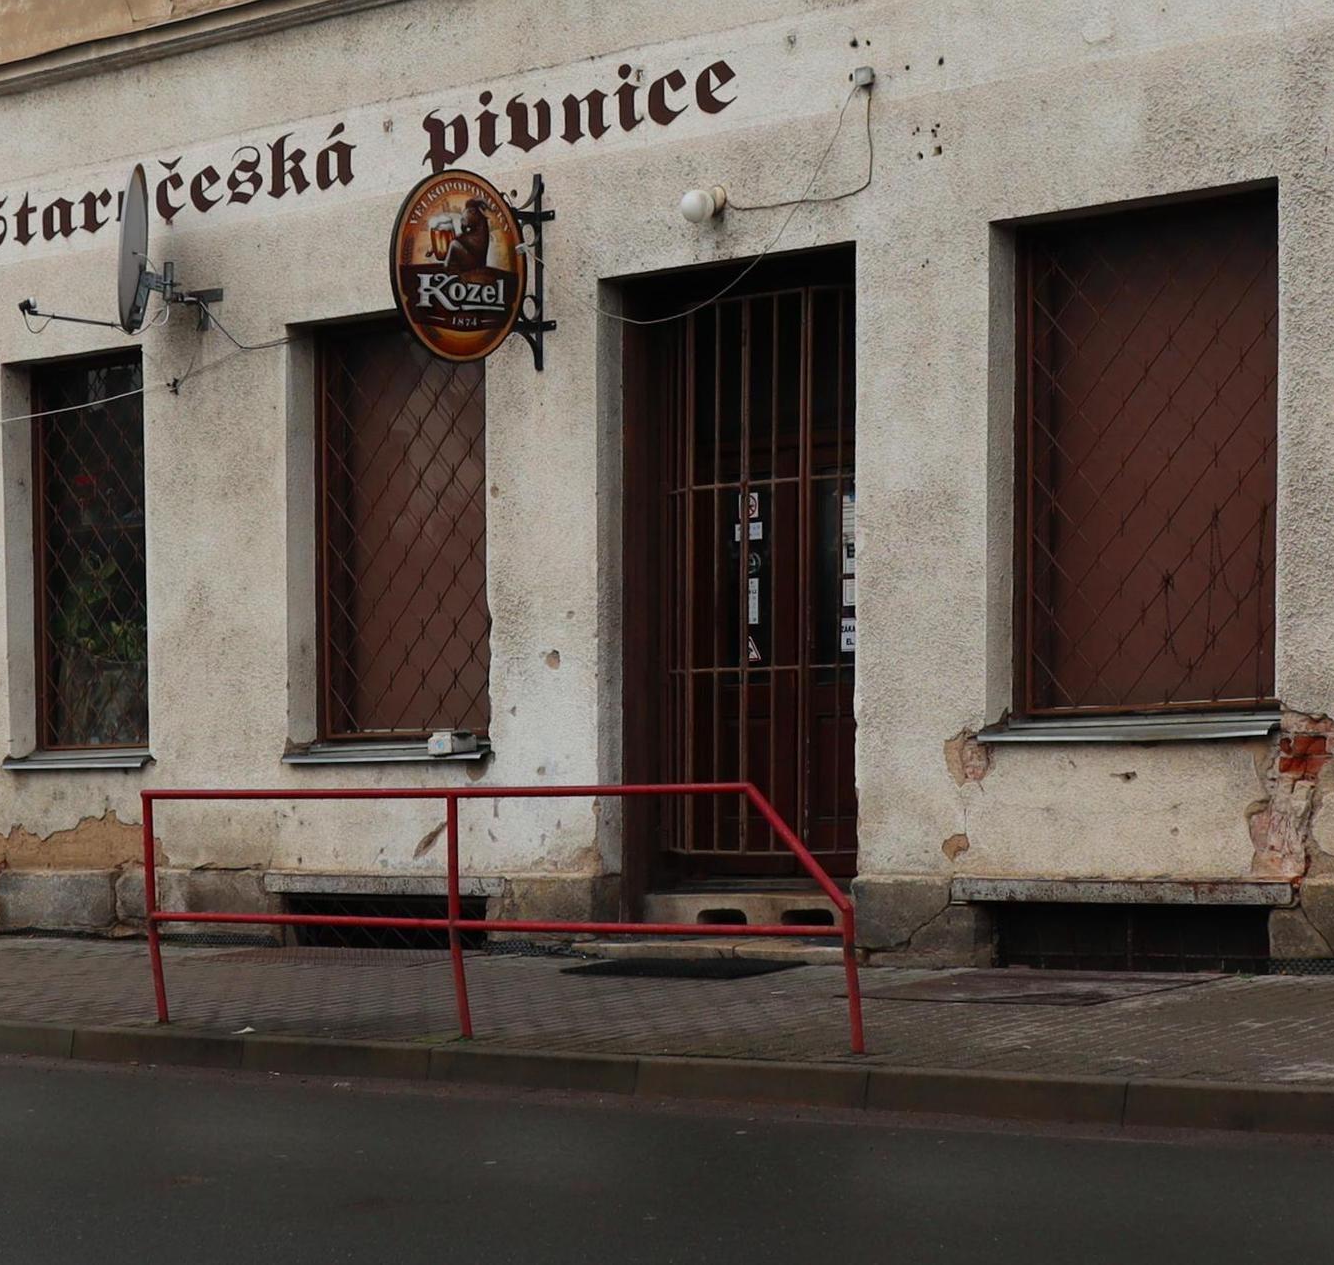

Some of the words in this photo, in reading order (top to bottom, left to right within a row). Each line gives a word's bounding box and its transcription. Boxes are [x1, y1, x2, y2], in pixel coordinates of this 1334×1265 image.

[422, 60, 739, 174] pivnice
[416, 273, 506, 311] Kozel
[451, 316, 478, 327] 1874
